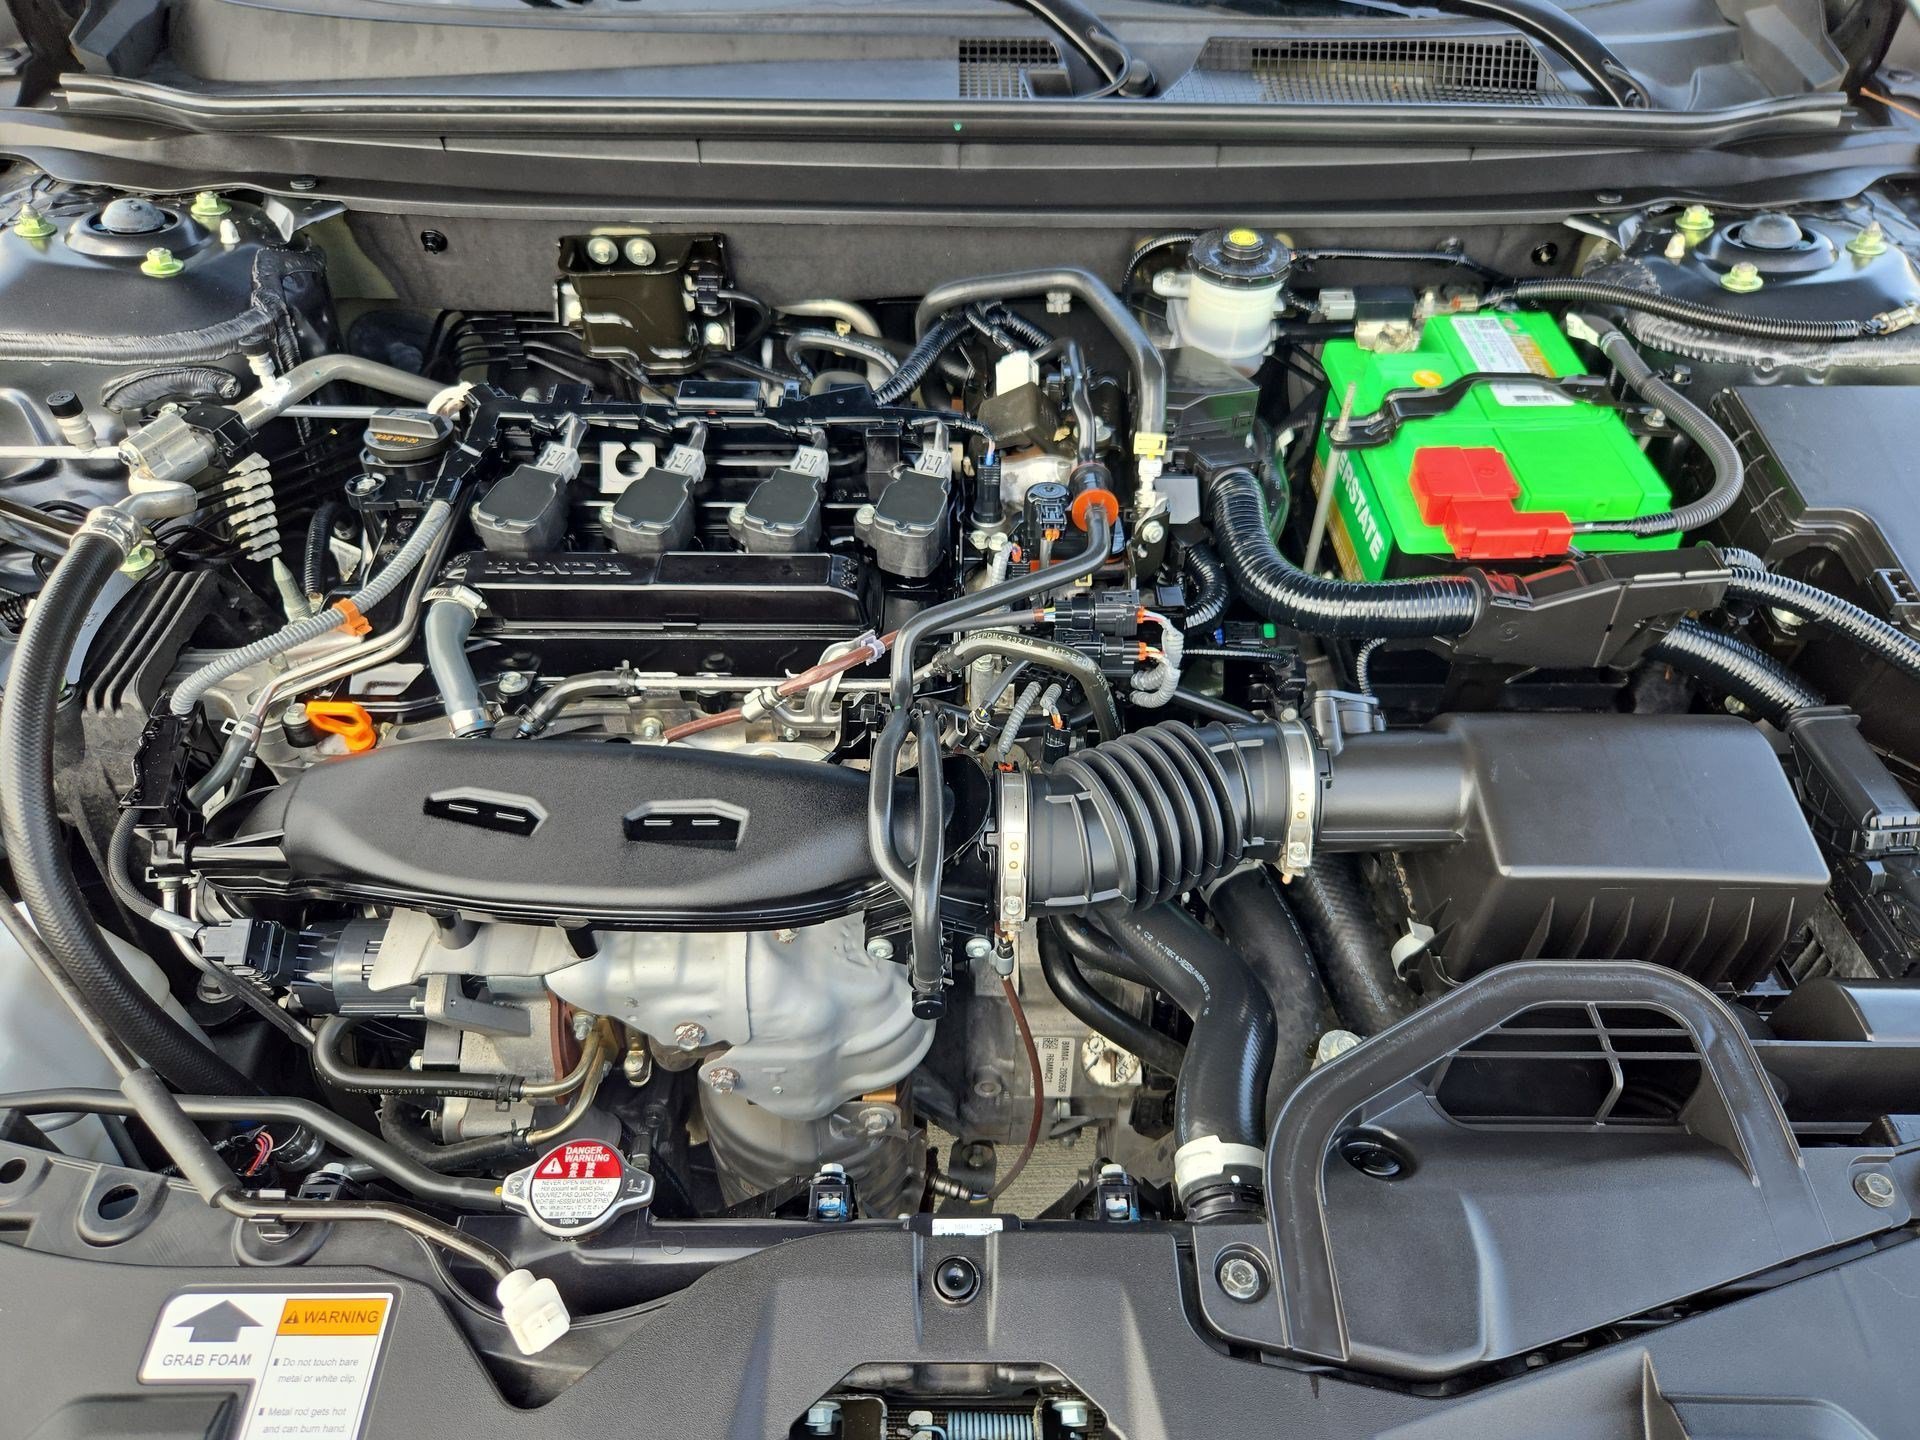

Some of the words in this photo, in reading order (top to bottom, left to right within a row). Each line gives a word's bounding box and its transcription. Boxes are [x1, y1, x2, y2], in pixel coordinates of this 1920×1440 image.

[1338, 450, 1385, 563] ERSTATE
[485, 561, 632, 576] HONDA
[565, 1146, 604, 1155] DANGER
[564, 1154, 610, 1163] WARNUNG
[304, 1310, 380, 1324] WARNING
[162, 1354, 205, 1366] GRAB
[208, 1353, 253, 1366] FOAM
[282, 1358, 294, 1367] Do
[296, 1358, 311, 1367] not
[313, 1357, 337, 1367] touch
[339, 1357, 359, 1367] bare
[277, 1374, 301, 1383] metal
[315, 1374, 340, 1383] white
[268, 1408, 293, 1416] Metal
[295, 1407, 309, 1416] rod
[310, 1408, 330, 1418] gets
[332, 1407, 347, 1416] hot
[263, 1425, 277, 1434] and
[280, 1426, 297, 1434] can
[300, 1425, 320, 1434] burn
